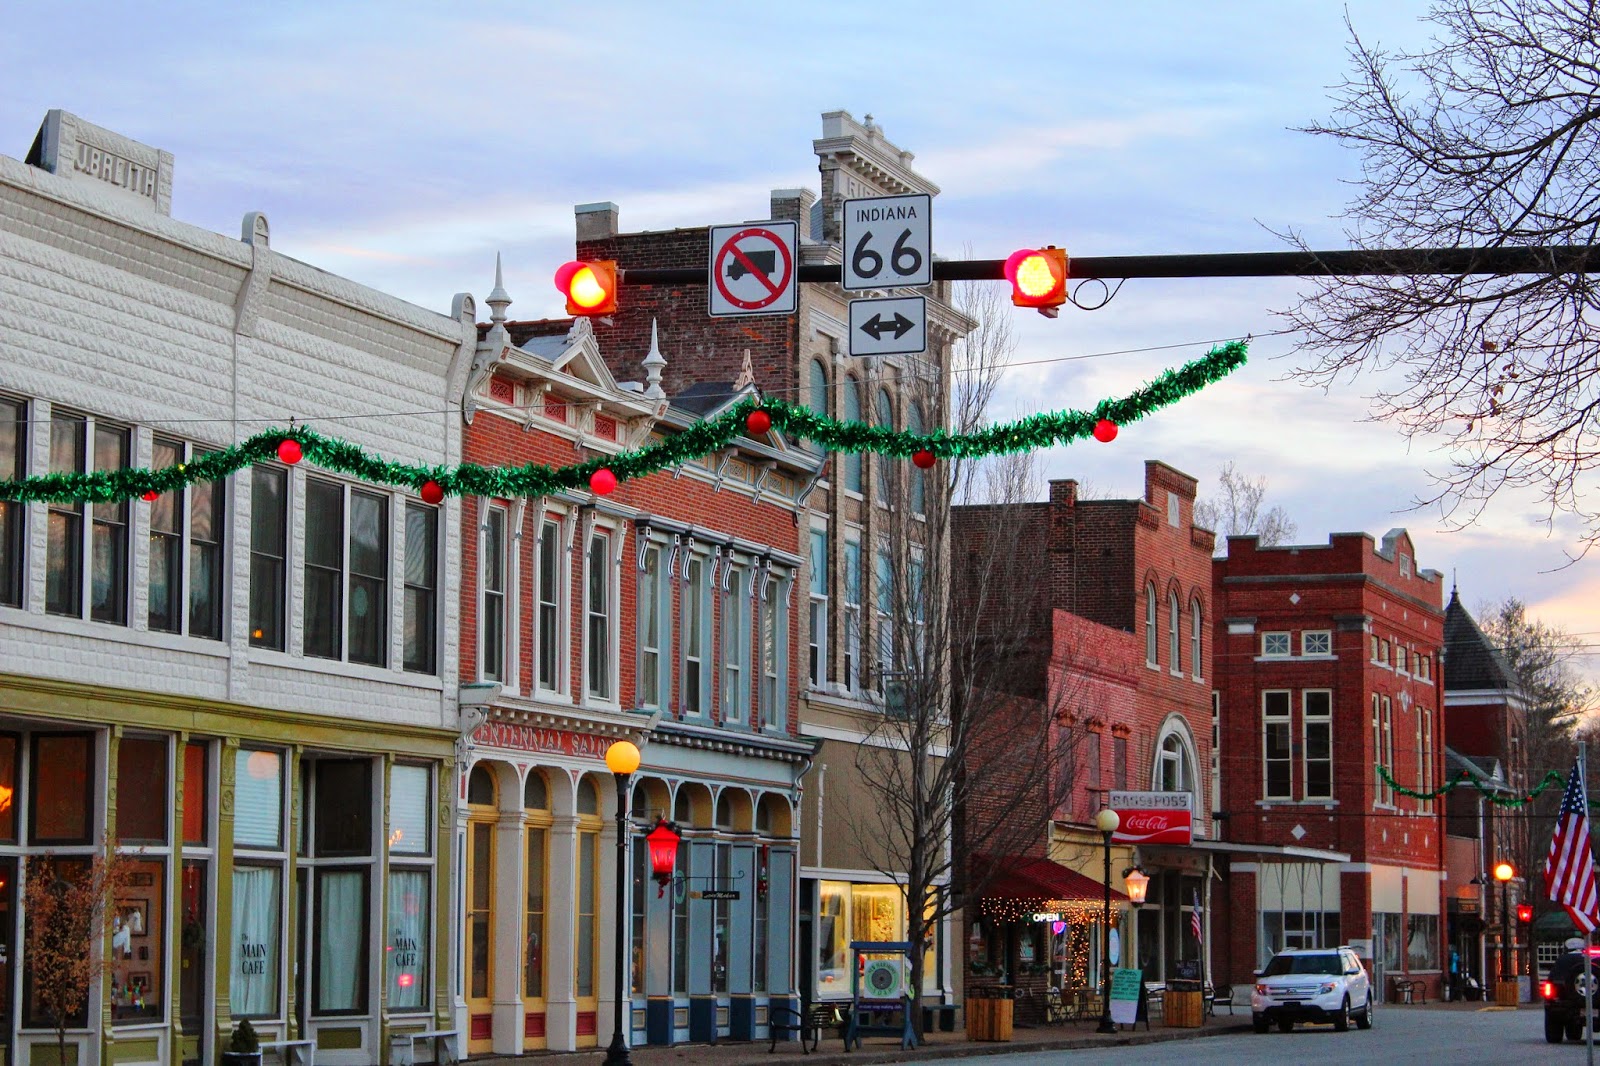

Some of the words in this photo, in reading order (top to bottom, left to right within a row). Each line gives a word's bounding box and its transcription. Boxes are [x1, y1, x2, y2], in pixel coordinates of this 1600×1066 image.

[856, 206, 917, 223] INDIANA
[852, 228, 922, 279] 66
[1126, 815, 1168, 830] Coca-Cola
[1032, 913, 1060, 922] OPEN
[241, 943, 267, 958] MAIN
[395, 937, 417, 951] MAIN
[241, 960, 265, 975] CAFE
[395, 953, 416, 967] CAFE
